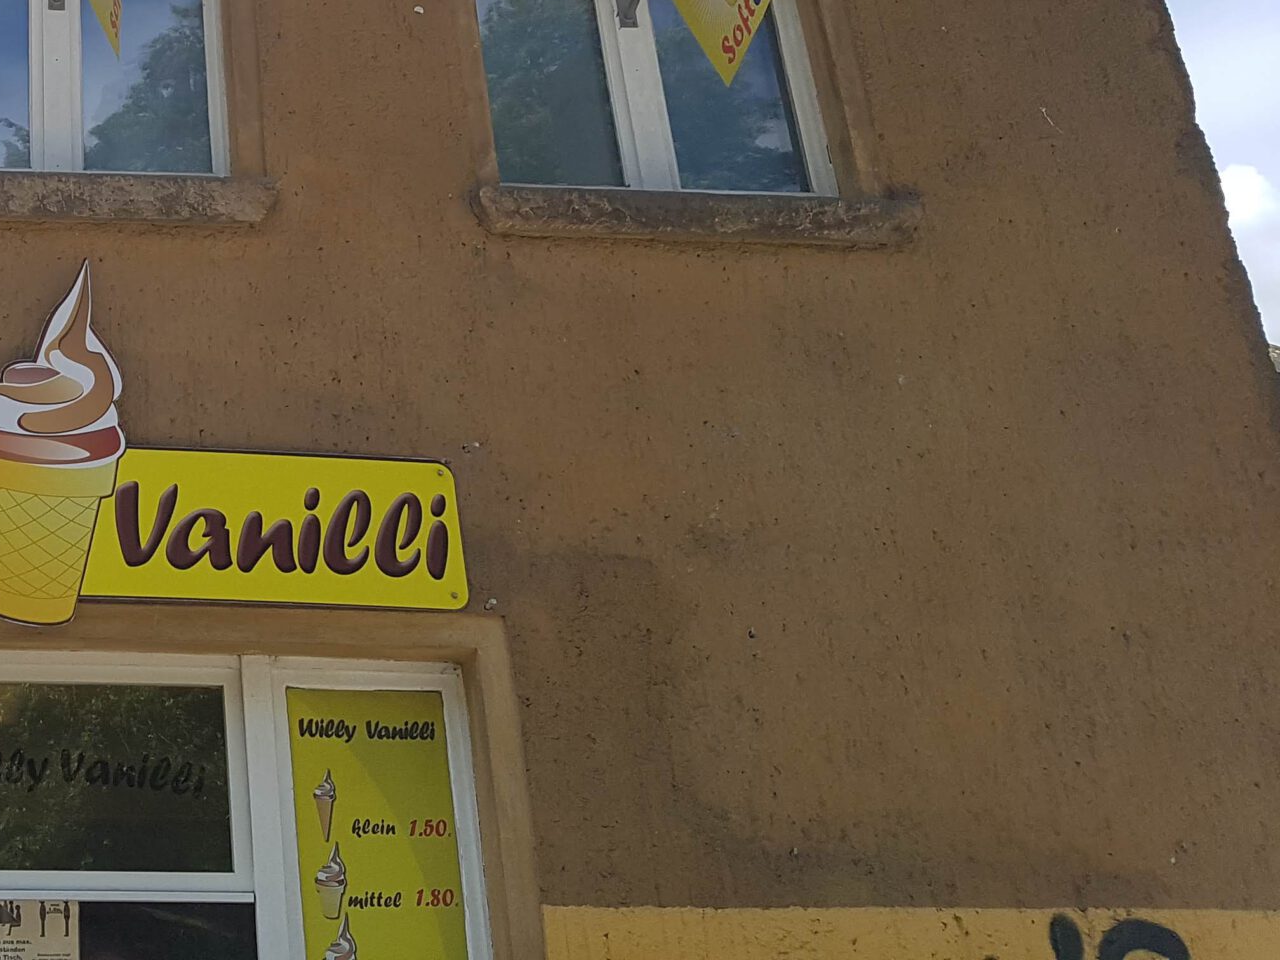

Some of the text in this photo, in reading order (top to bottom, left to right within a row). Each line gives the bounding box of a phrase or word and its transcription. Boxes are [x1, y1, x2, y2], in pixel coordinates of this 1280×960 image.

[114, 480, 449, 581] Vanilli
[298, 718, 436, 743] Willy Vanilli
[60, 748, 206, 798] Vanilli
[351, 819, 396, 838] klein
[347, 892, 402, 909] mittel
